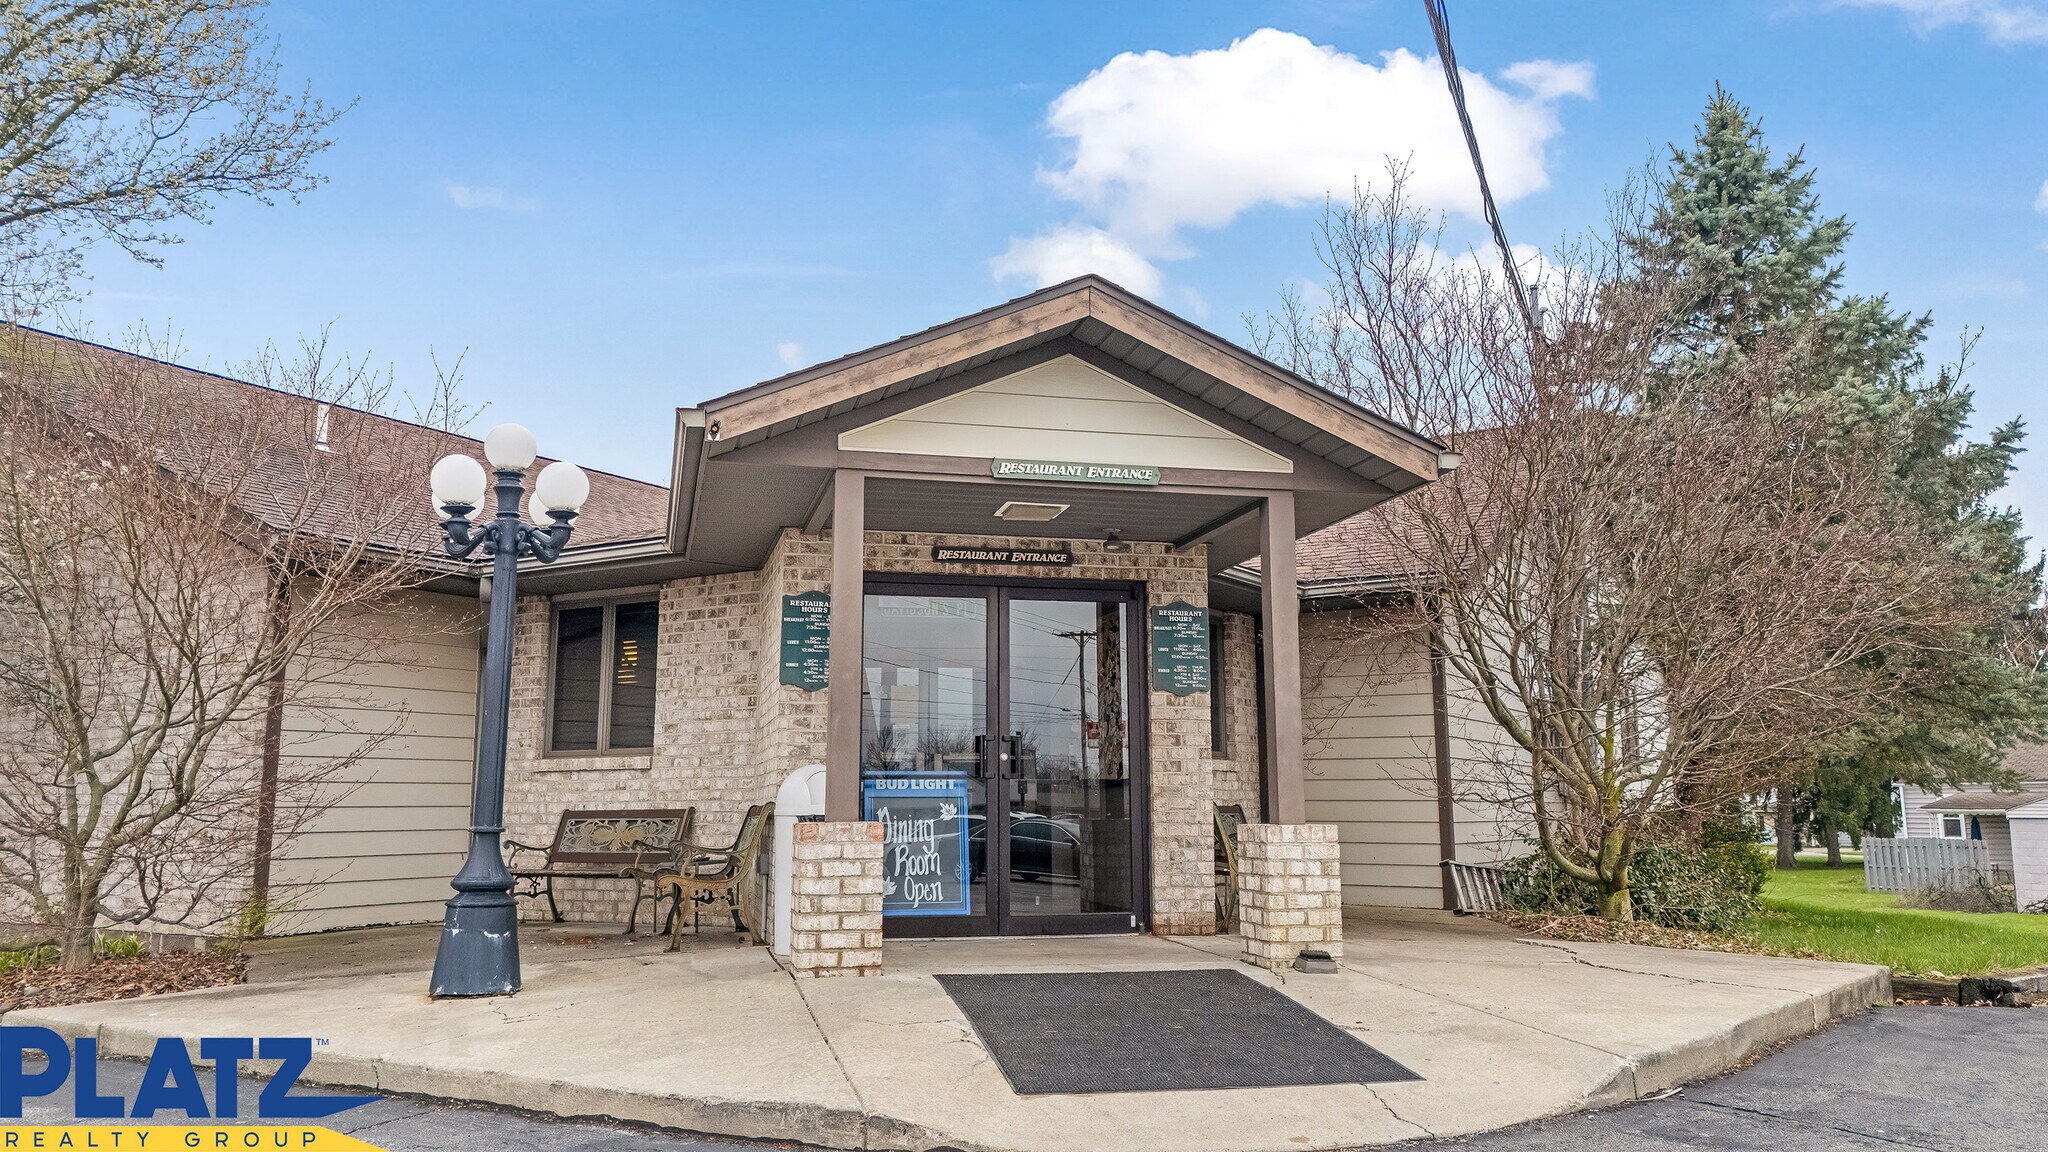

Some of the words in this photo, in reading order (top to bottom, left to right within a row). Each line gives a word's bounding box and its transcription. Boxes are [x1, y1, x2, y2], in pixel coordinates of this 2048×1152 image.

[999, 462, 1083, 476] RESTAURANT
[1087, 467, 1152, 480] ENTRANCE
[937, 550, 1008, 561] RESTAURANT
[1011, 552, 1067, 562] ENTRANCE
[876, 779, 909, 789] BUD
[911, 779, 956, 789] LIGHT
[876, 806, 935, 854] Dining
[894, 845, 941, 876] Room
[904, 876, 944, 908] Open
